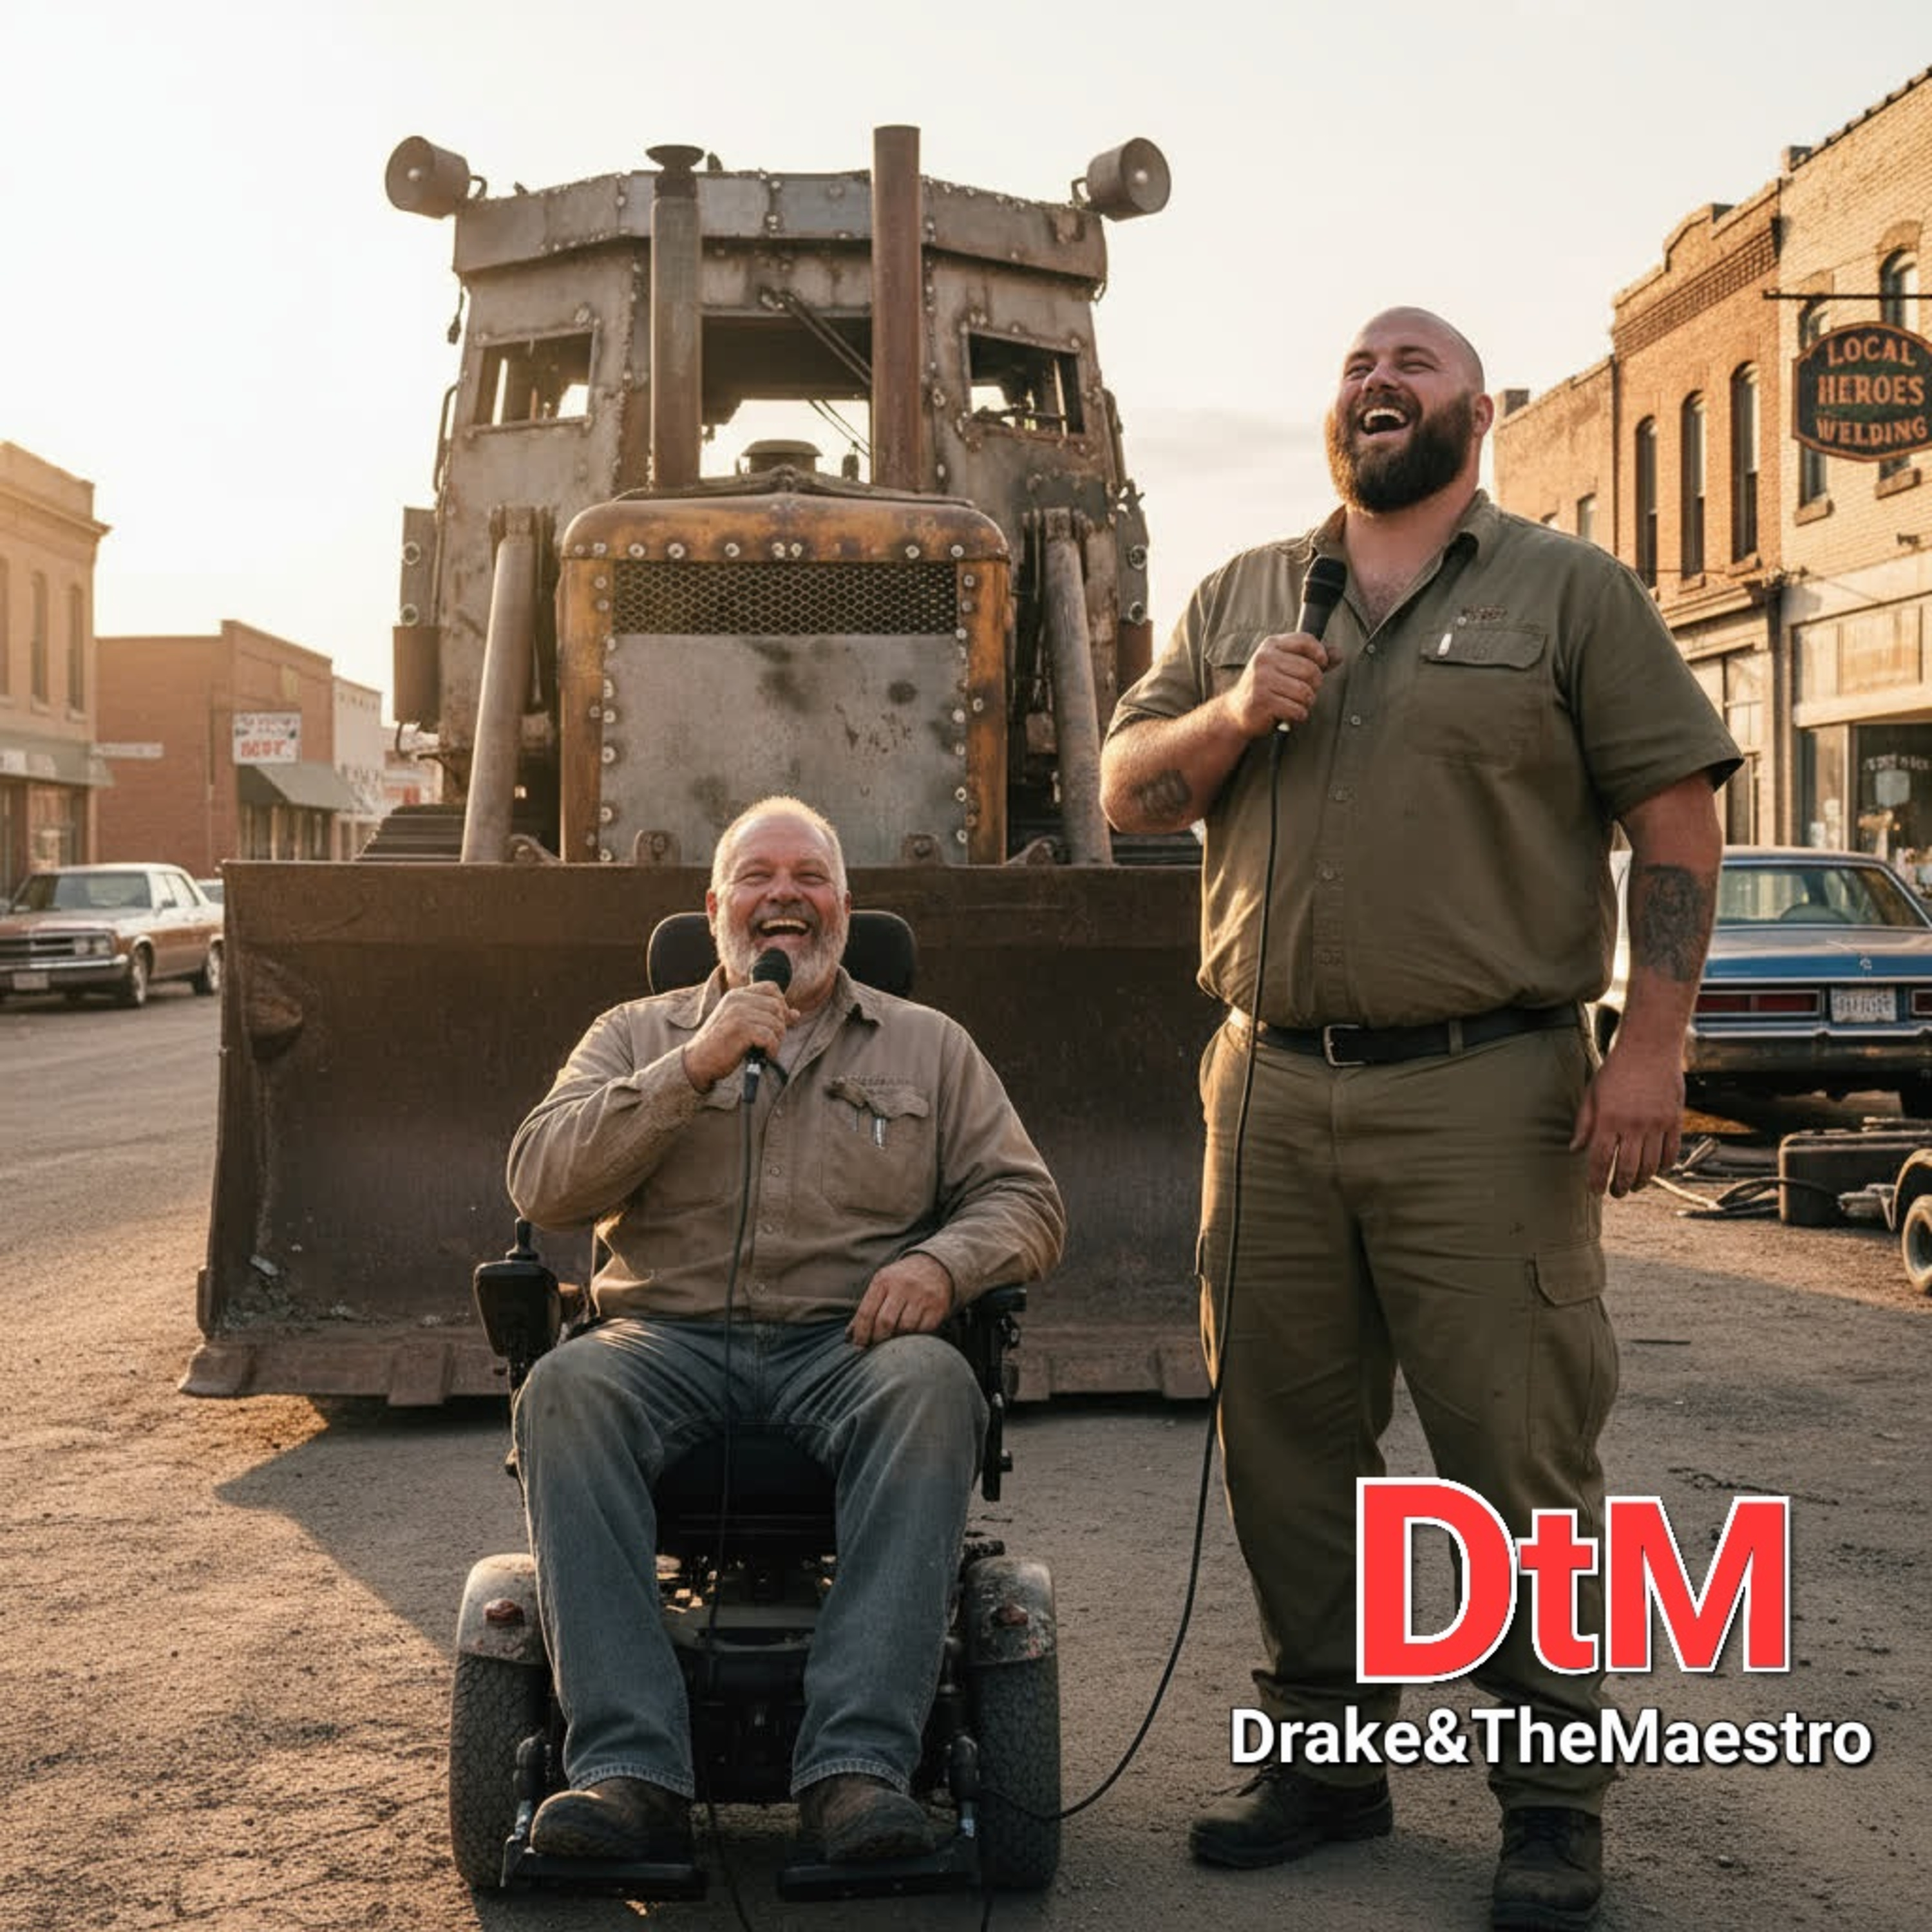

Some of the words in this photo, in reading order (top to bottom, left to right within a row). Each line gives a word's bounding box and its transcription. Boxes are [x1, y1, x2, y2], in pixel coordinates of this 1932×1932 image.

[1826, 336, 1917, 367] LOCAL
[1817, 375, 1926, 406] HEROES
[1816, 415, 1927, 446] WELDING
